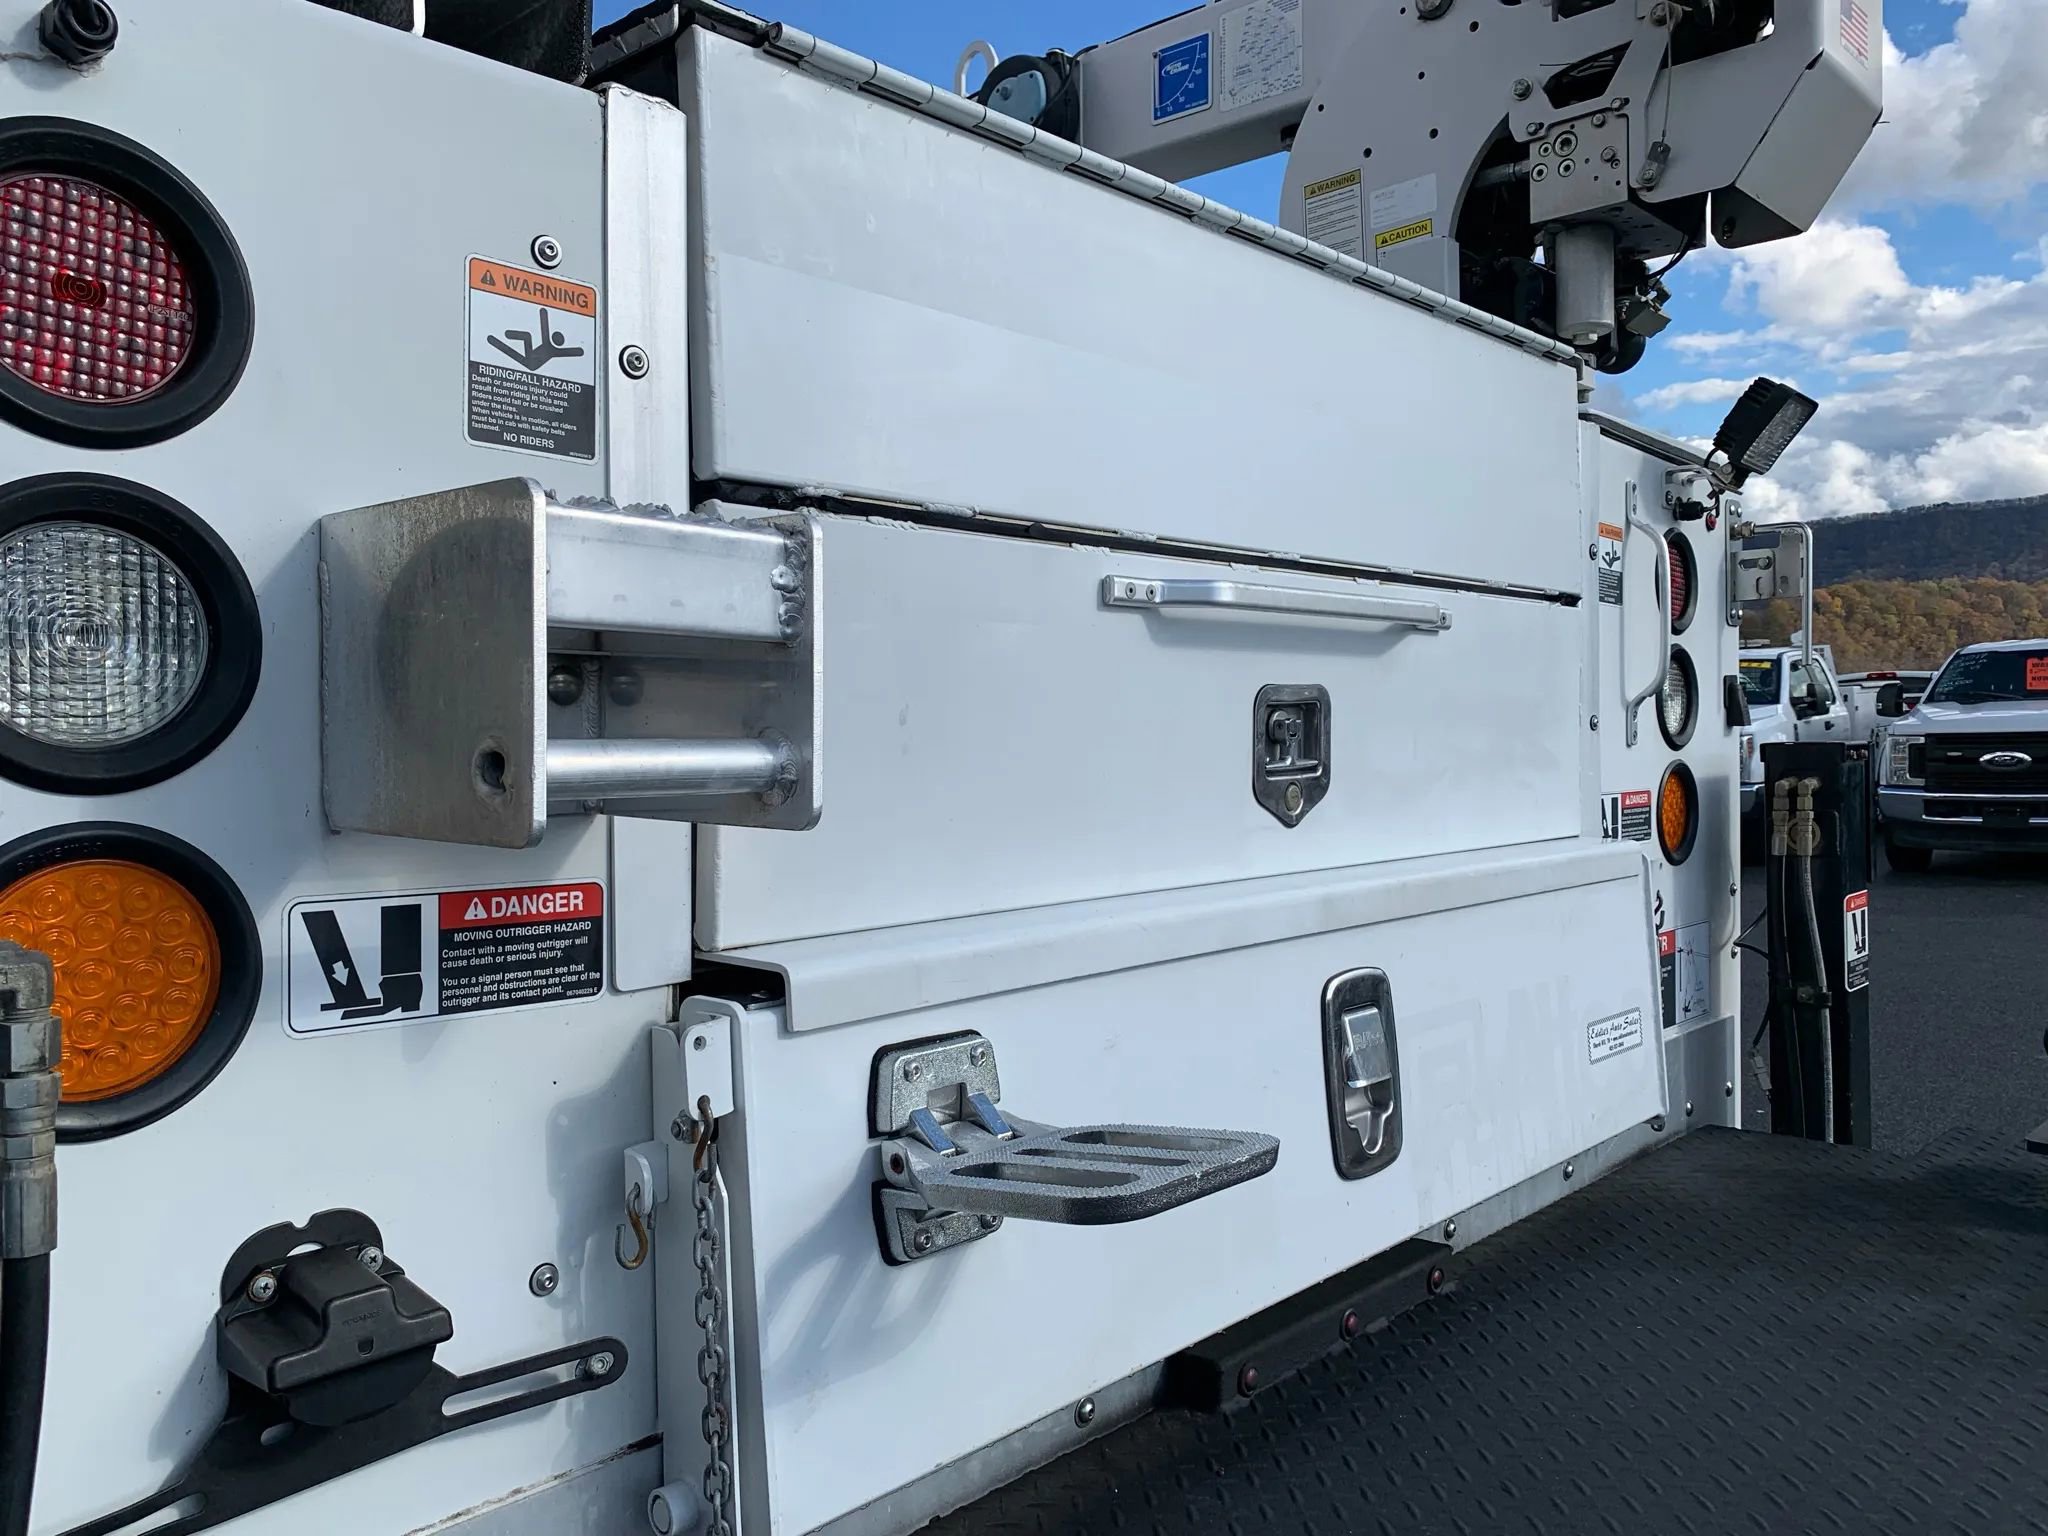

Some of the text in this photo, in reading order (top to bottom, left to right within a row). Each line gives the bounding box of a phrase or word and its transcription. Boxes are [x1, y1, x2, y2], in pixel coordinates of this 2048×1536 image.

[1317, 174, 1355, 193] WARNING
[1389, 224, 1428, 241] CAUTION
[503, 274, 588, 309] WARNING
[472, 374, 492, 383] Death
[503, 380, 528, 391] serious
[530, 387, 548, 395] injury
[480, 365, 581, 393] RIDING/FALL HAZARD
[472, 384, 491, 392] result
[494, 386, 509, 395] from
[511, 390, 530, 400] riding
[540, 395, 552, 403] this
[472, 391, 492, 400] Riders
[494, 394, 511, 403] could
[512, 397, 521, 405] fall
[539, 404, 563, 413] crushed
[472, 399, 489, 407] under
[502, 404, 518, 412] tires.
[472, 406, 490, 415] When
[492, 411, 513, 419] vehicle
[528, 417, 550, 426] motion,
[560, 421, 576, 430] riders
[472, 421, 500, 431] fastened.
[518, 421, 530, 429] with
[532, 423, 549, 434] safety
[551, 427, 565, 436] belts
[504, 432, 555, 448] NO RIDERS
[492, 891, 583, 918] DANGER
[454, 922, 591, 942] MOVING OUTRIGGER HAZARD
[442, 948, 475, 958] Contact
[478, 946, 495, 955] with
[505, 942, 534, 953] moving
[537, 938, 572, 951] outrigger
[575, 936, 588, 945] will
[442, 960, 467, 968] cause
[470, 956, 493, 966] death
[507, 952, 536, 961] serious
[539, 950, 563, 961] injury.
[442, 978, 458, 987] You
[479, 972, 502, 984] signal
[505, 970, 532, 981] person
[534, 967, 553, 976] must
[570, 964, 584, 972] that
[442, 986, 481, 999] personnel
[483, 983, 498, 992] and
[500, 979, 546, 991] obstructions
[561, 973, 579, 983] clear
[581, 972, 588, 980] of
[590, 971, 600, 979] the
[442, 985, 564, 1008] outrigger and its contact point.
[1591, 1017, 1639, 1039] Eddie's Auto Sales
